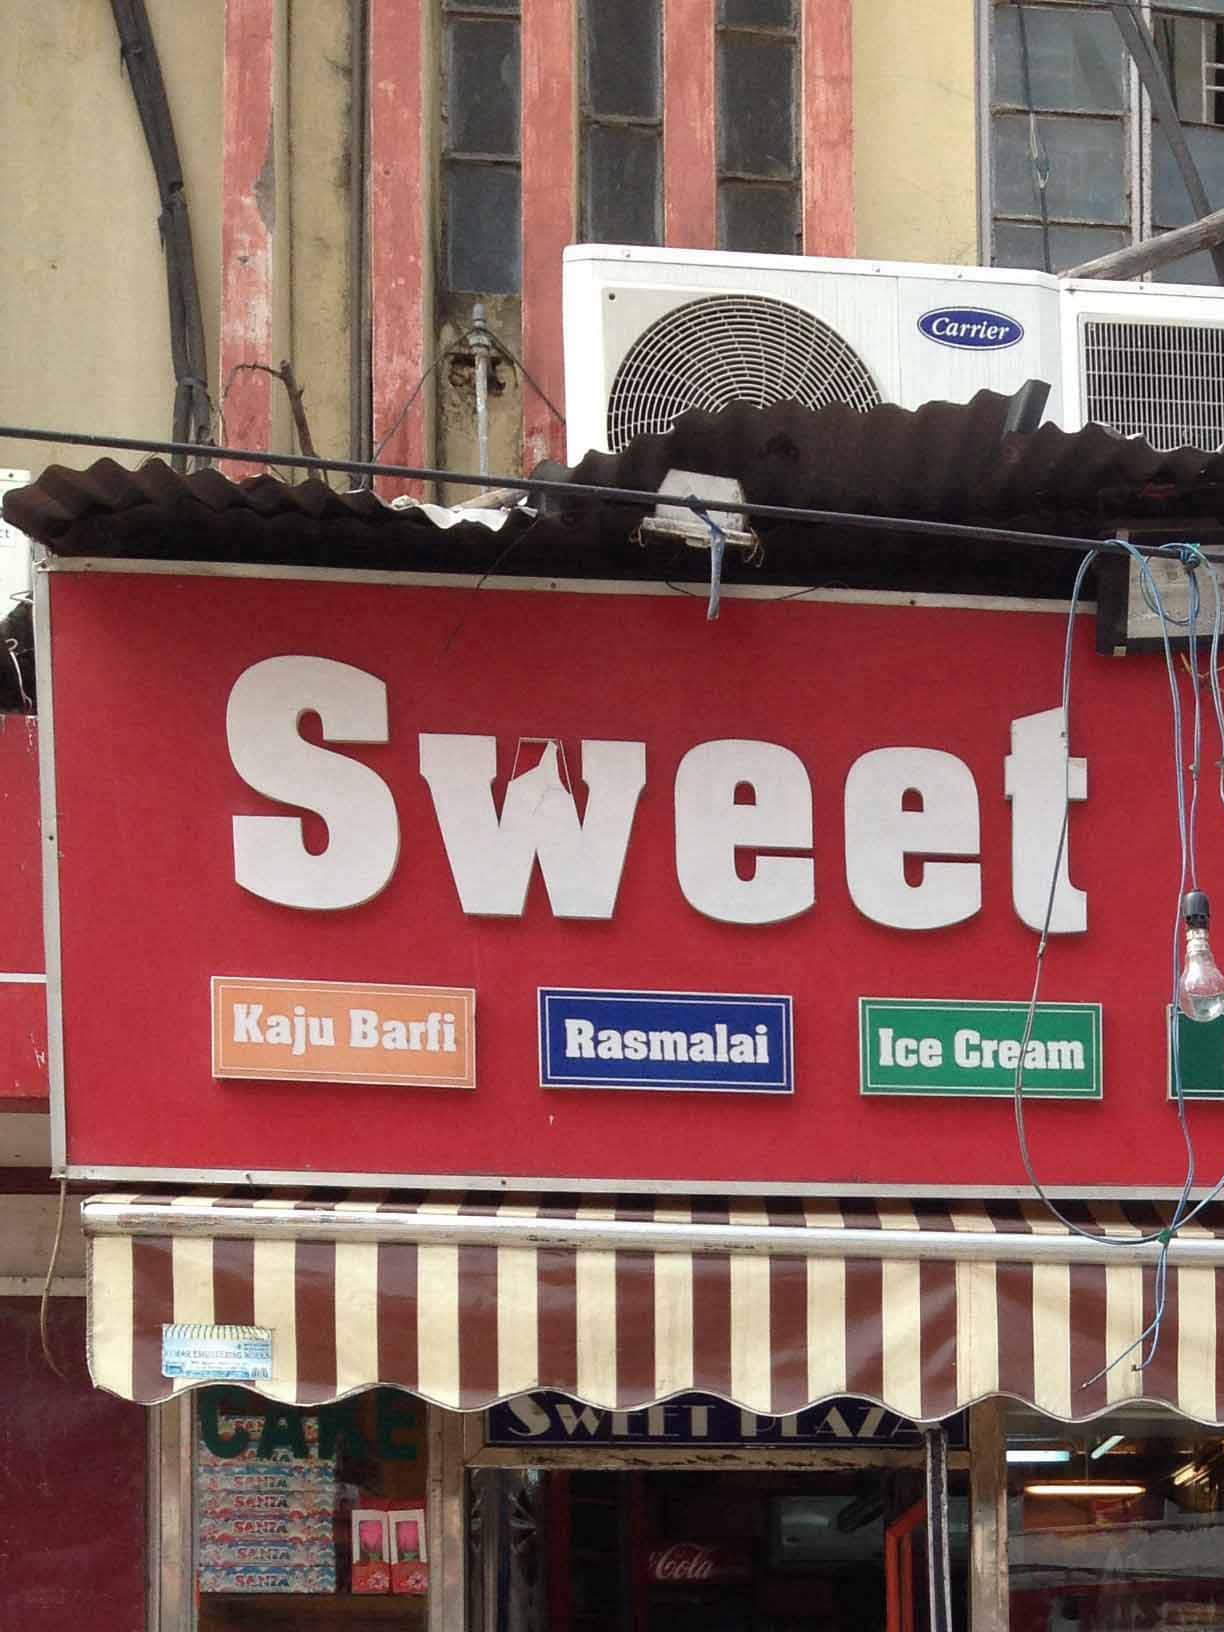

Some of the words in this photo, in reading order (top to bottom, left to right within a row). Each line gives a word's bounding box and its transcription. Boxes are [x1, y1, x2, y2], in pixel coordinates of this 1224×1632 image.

[931, 316, 1010, 340] Carrier
[226, 653, 1088, 935] Sweet
[232, 1002, 335, 1056] Kaju
[348, 1008, 457, 1054] Barfi
[563, 1016, 770, 1065] Rasmalai
[878, 1027, 944, 1070] Ice
[953, 1030, 1085, 1071] Cream
[200, 1386, 422, 1458] CAKE
